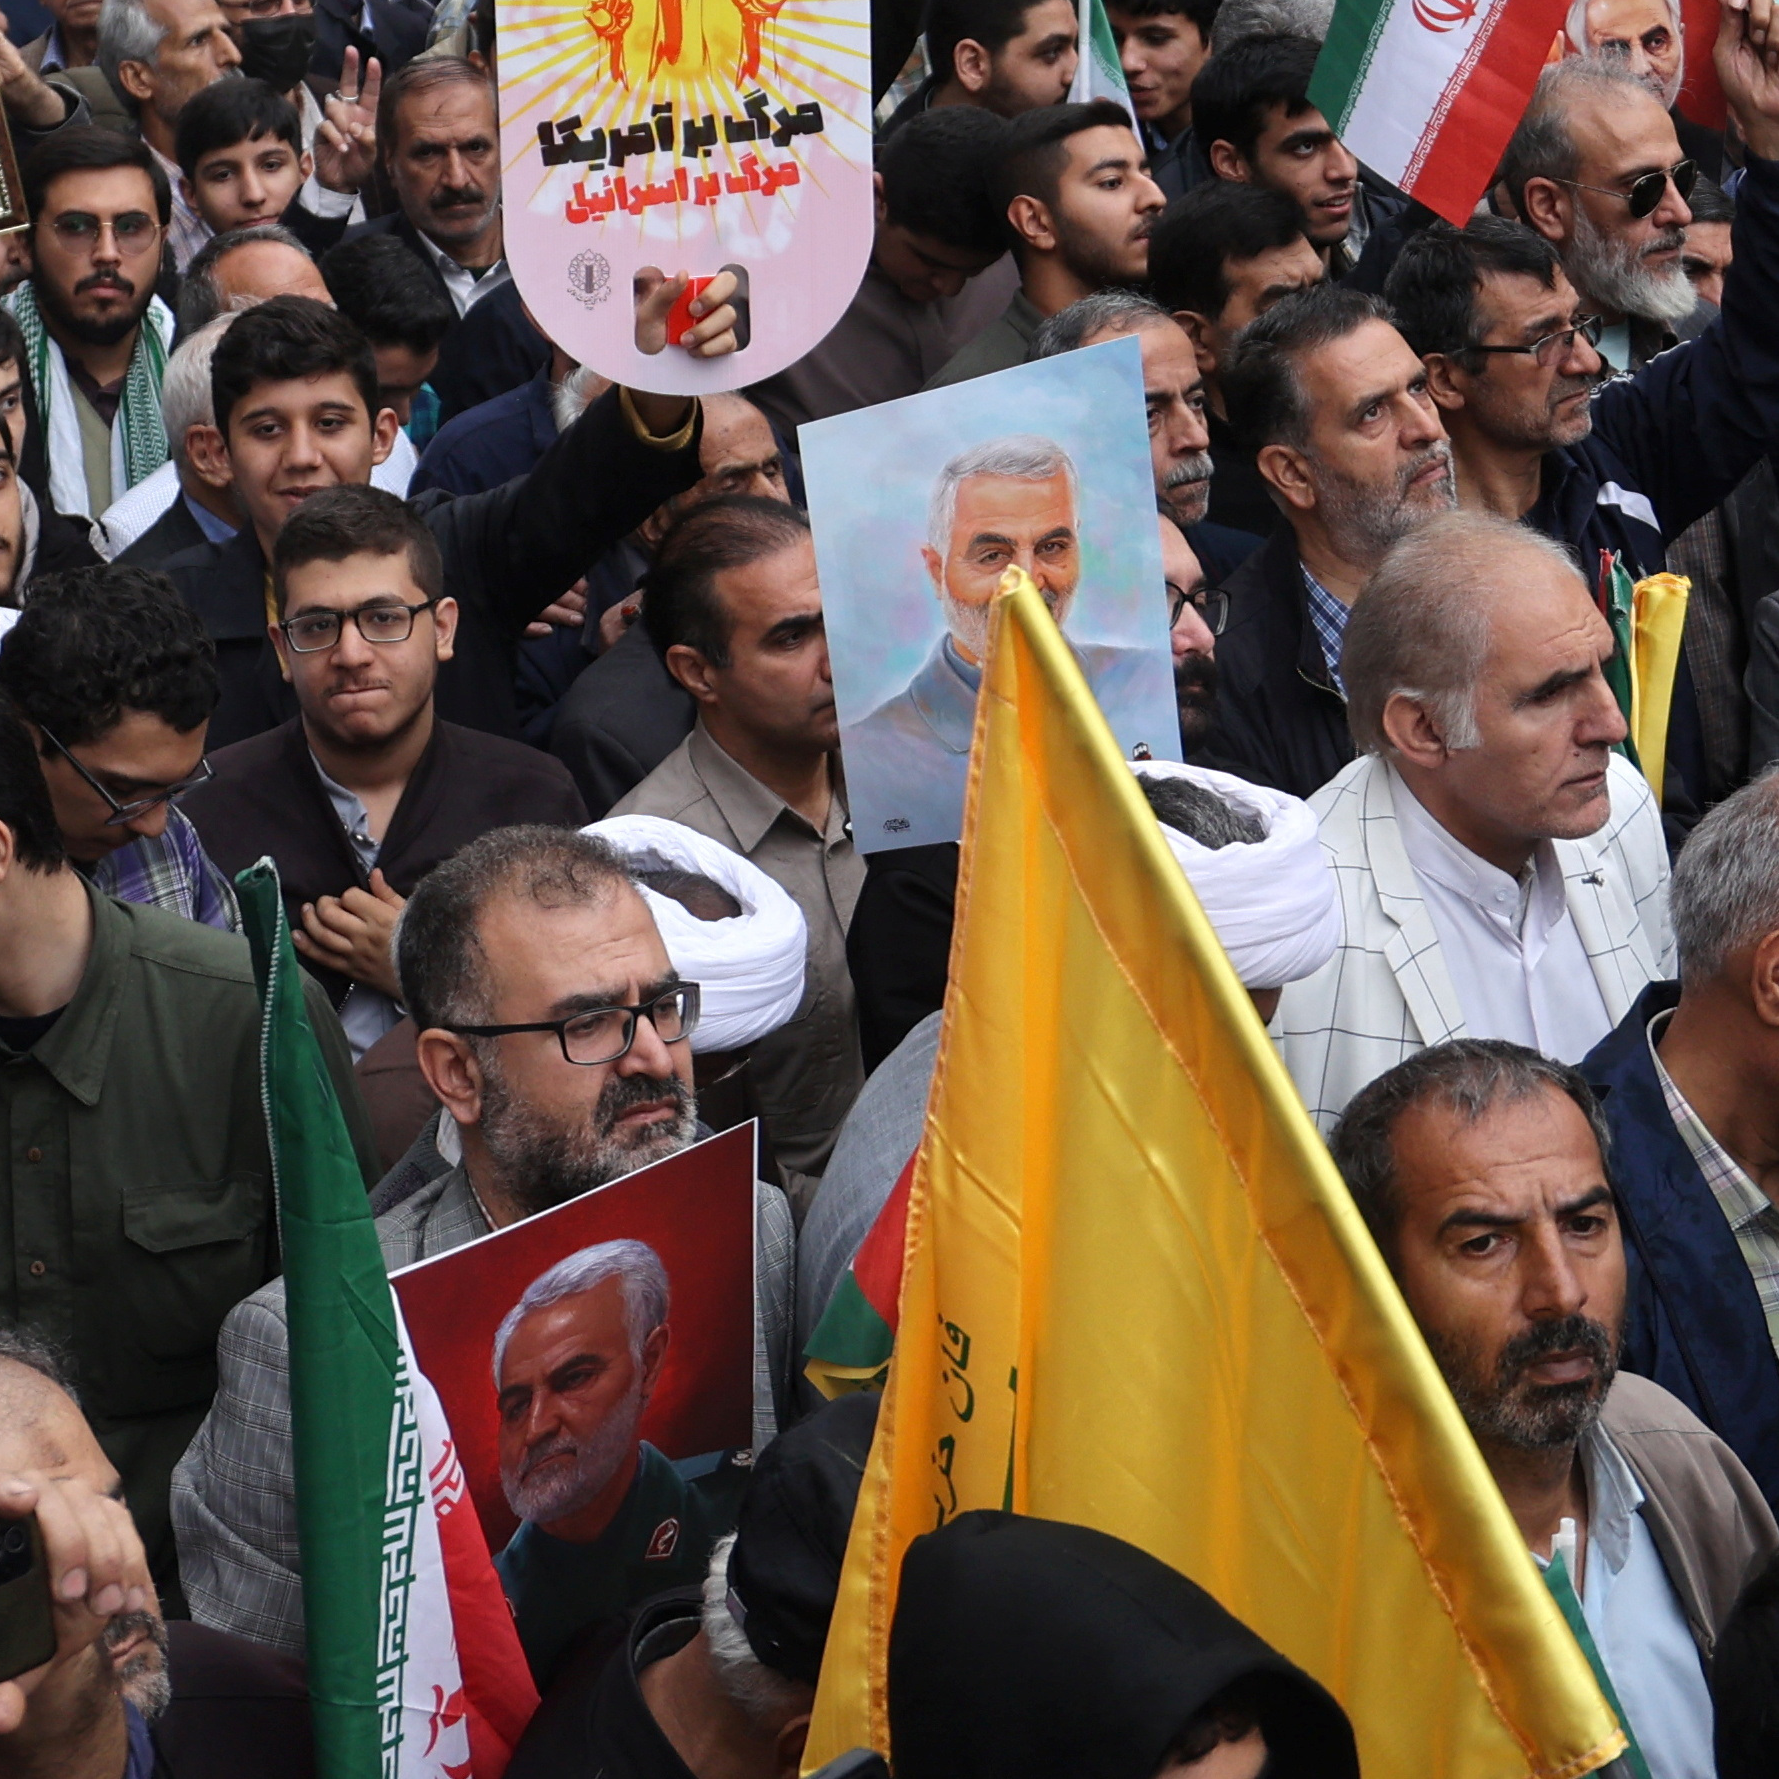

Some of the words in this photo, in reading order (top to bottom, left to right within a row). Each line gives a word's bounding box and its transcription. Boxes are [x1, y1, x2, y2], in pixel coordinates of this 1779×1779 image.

[536, 101, 675, 171] آمریکا
[680, 110, 718, 158] بر
[725, 88, 824, 149] مرگ
[565, 165, 689, 224] اسرائیل
[694, 170, 721, 206] بر
[725, 151, 800, 196] مرگ
